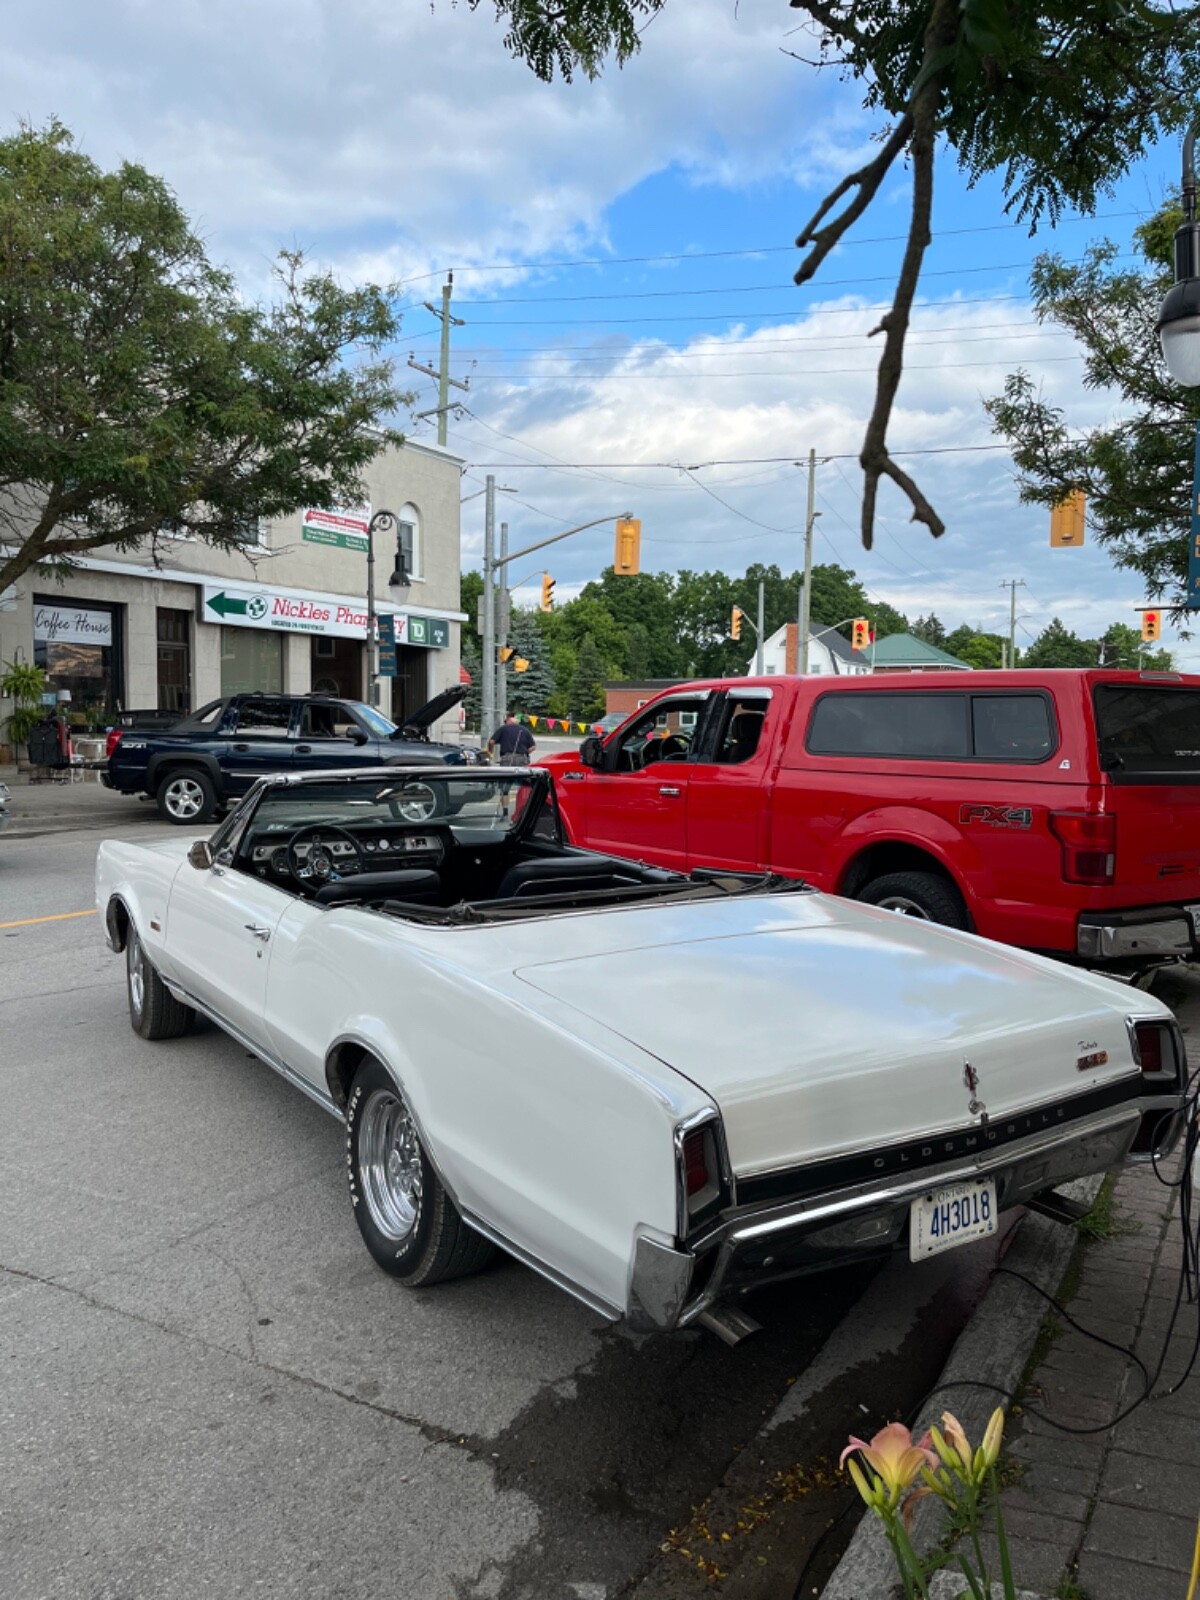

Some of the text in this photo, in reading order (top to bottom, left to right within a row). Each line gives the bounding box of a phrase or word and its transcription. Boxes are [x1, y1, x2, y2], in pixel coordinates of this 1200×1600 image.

[35, 608, 110, 639] Coffee House
[271, 597, 330, 622] Nickles
[411, 623, 424, 637] TD
[959, 803, 1033, 825] FX4
[873, 1108, 1065, 1169] OLDSMOBILE
[930, 1189, 991, 1238] 4H3018
